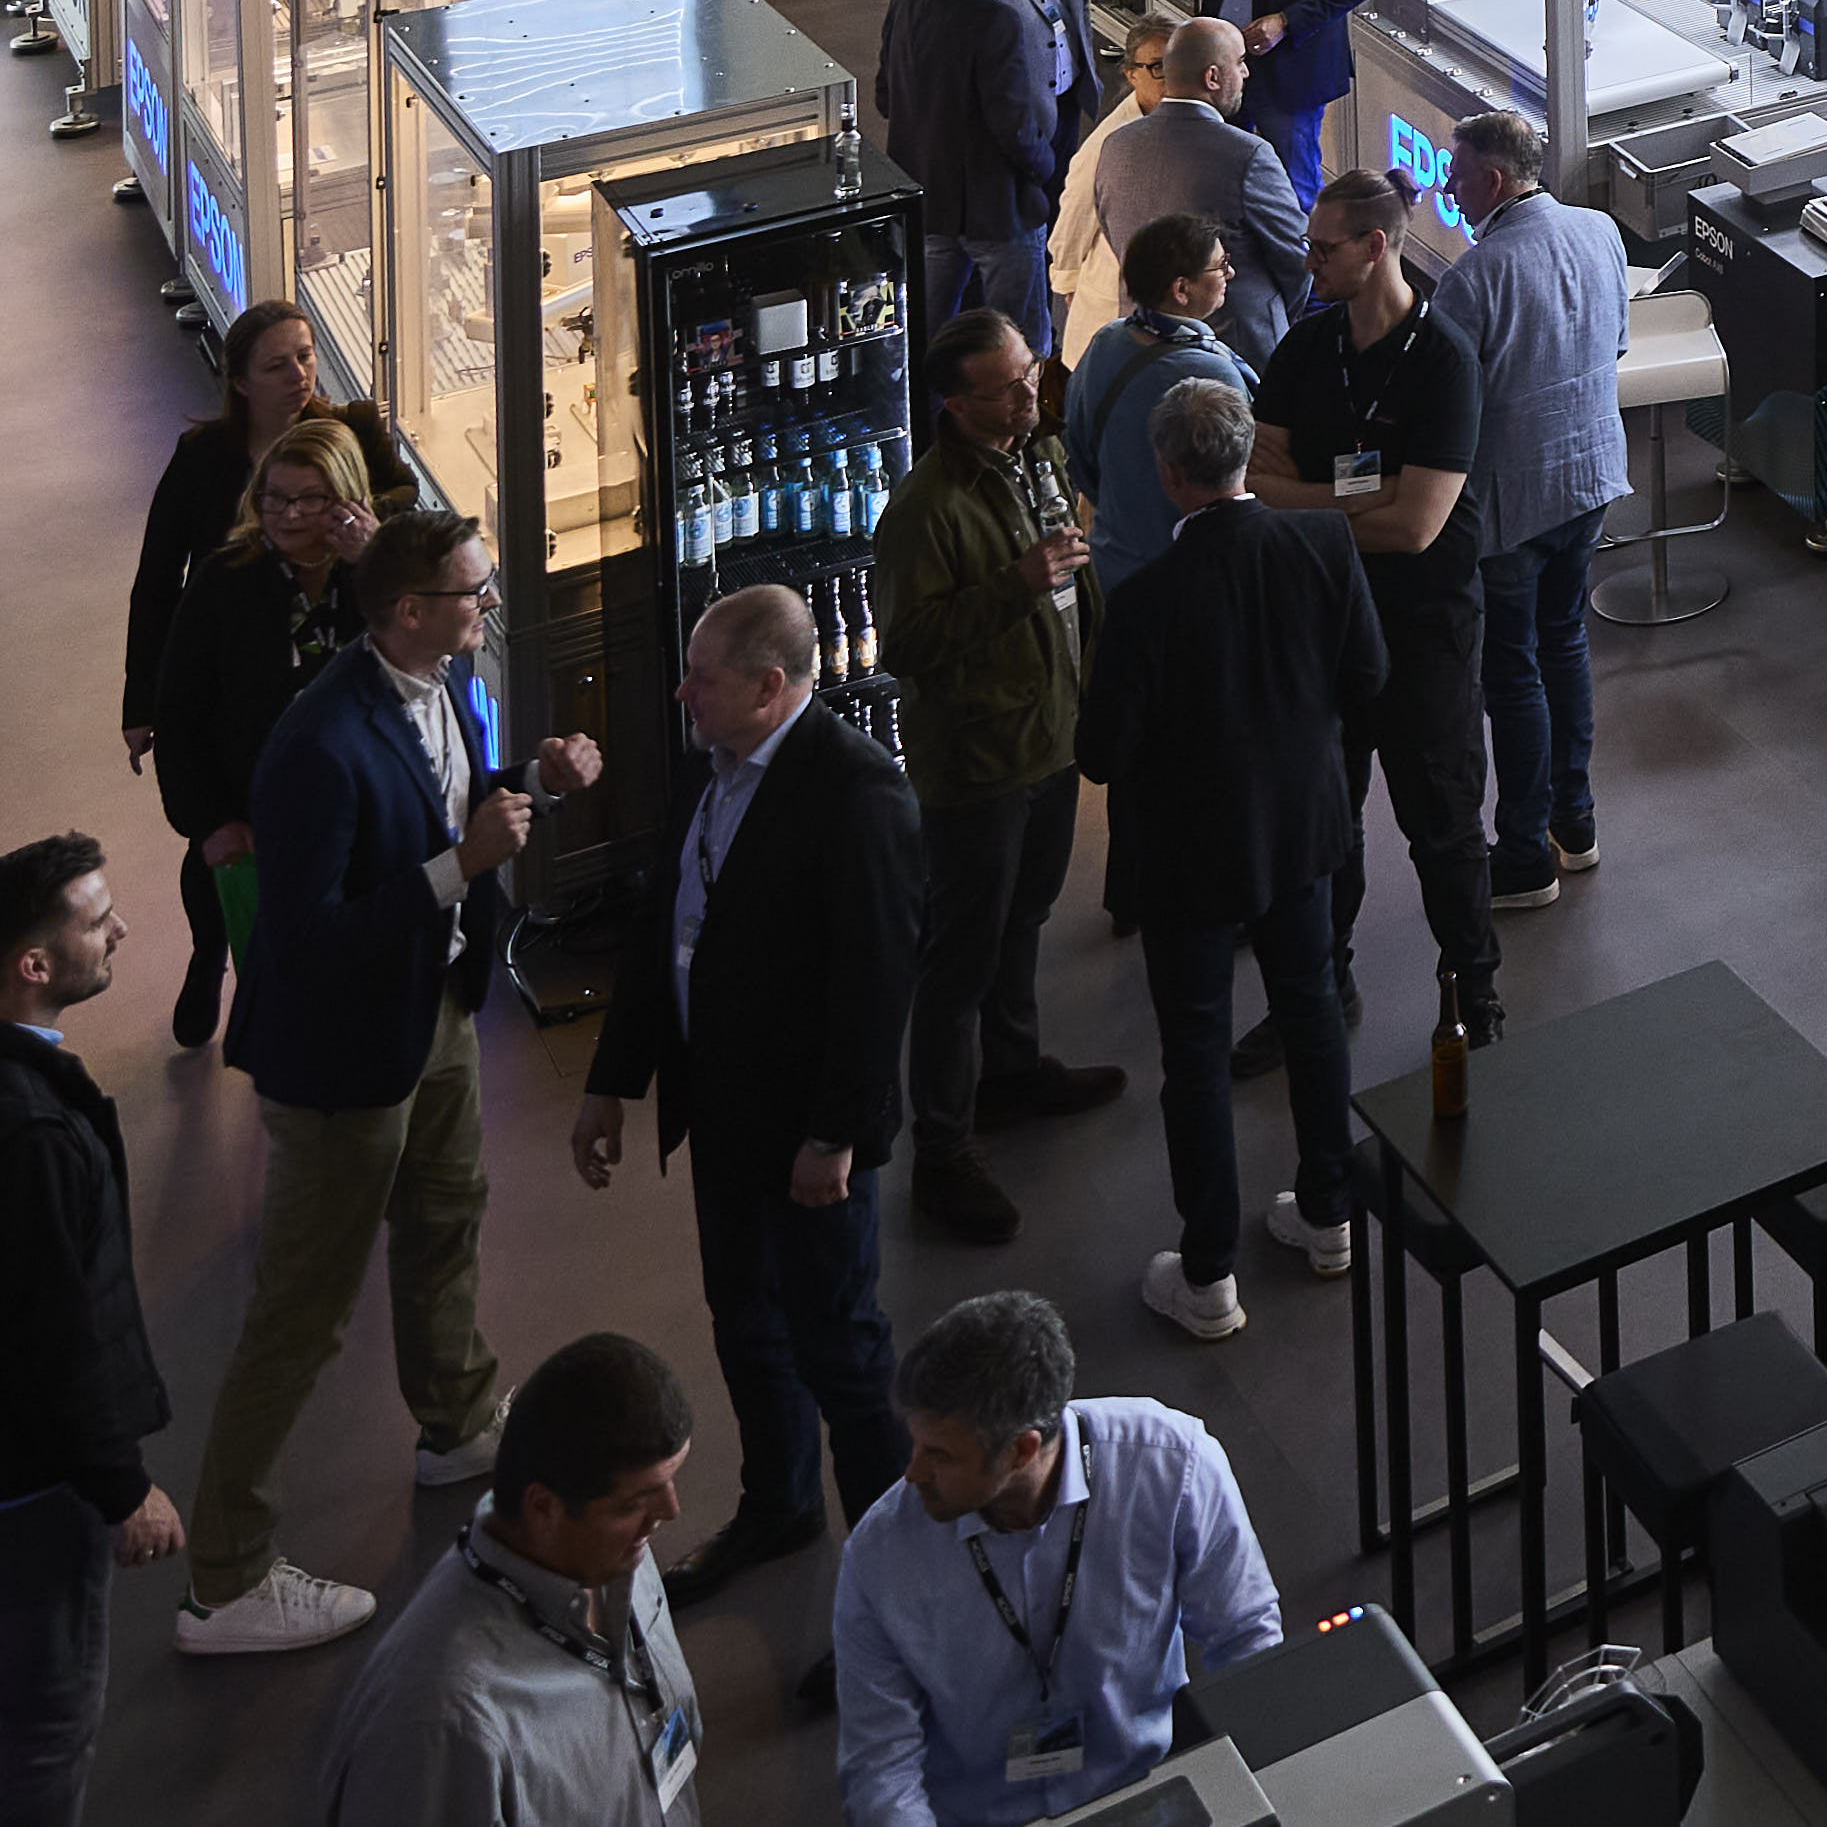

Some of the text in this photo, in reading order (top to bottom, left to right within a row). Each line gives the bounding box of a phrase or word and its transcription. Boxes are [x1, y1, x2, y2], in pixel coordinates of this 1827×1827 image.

[126, 36, 168, 177] EPSON
[187, 159, 246, 312] EPSON
[1390, 112, 1479, 247] EPS
[1694, 215, 1734, 260] EPSON
